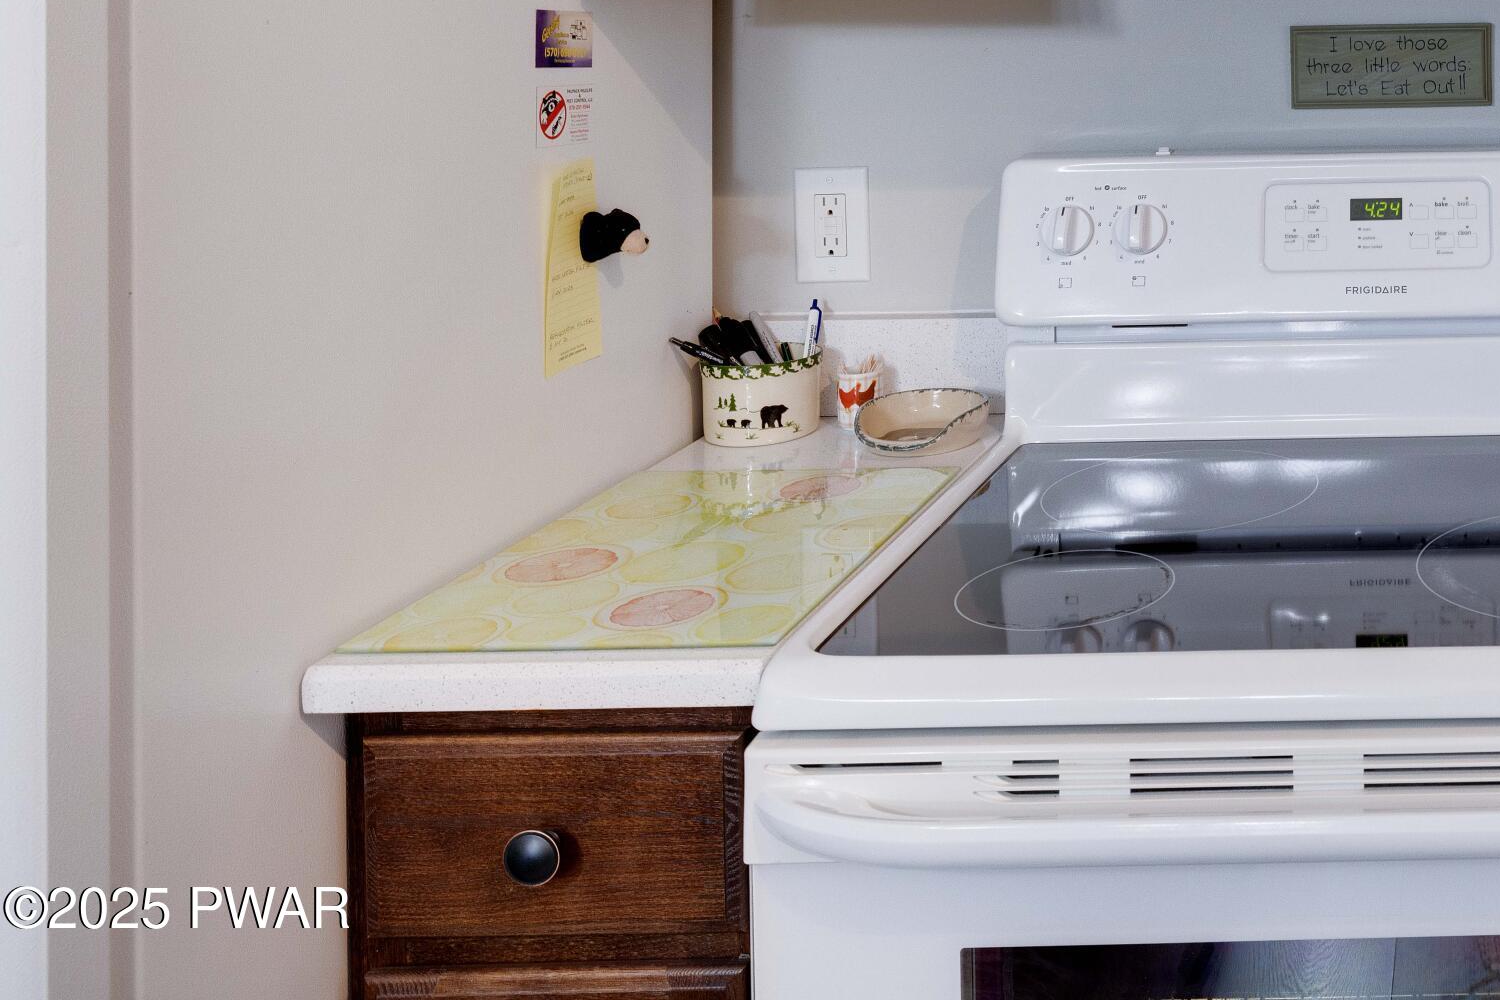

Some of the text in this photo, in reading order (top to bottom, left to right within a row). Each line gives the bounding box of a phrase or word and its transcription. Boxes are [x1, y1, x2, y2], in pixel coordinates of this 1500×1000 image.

[1329, 35, 1449, 53] I love those
[1306, 57, 1354, 76] three
[1365, 56, 1400, 73] little
[1326, 72, 1466, 97] Let's Eat Out!!
[1364, 201, 1400, 218] 4:24
[1345, 285, 1408, 295] FRIGIDAIRE
